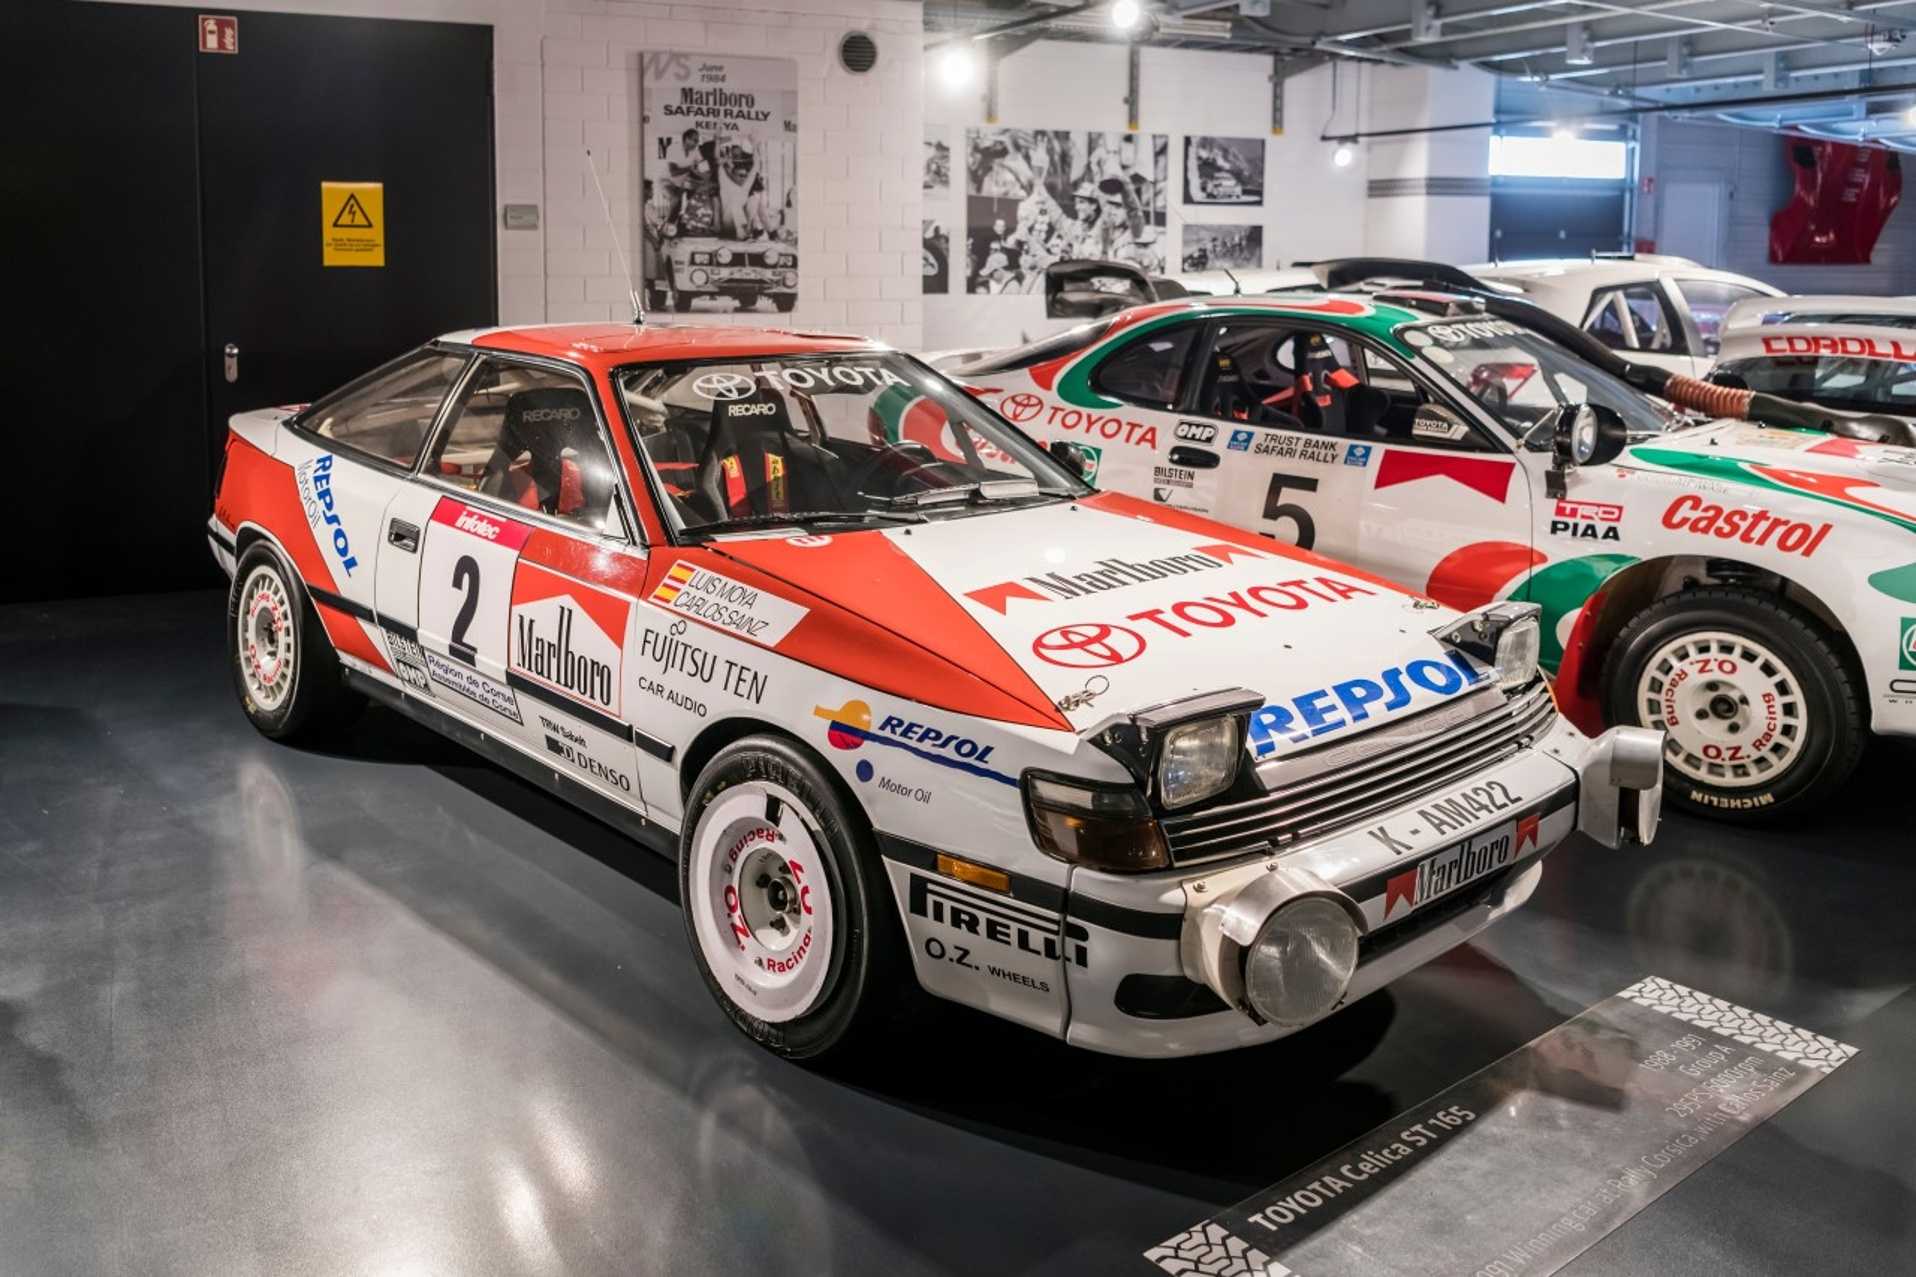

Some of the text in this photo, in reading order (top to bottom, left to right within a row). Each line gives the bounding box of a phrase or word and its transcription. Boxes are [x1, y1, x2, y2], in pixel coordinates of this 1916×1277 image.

[698, 63, 724, 73] June
[700, 74, 727, 83] 1984
[663, 104, 771, 121] SAFARI RALLY
[680, 87, 755, 108] Marlboro
[754, 366, 911, 391] TOYOTA
[522, 407, 581, 422] RECARO
[728, 403, 776, 417] RECARO
[1048, 406, 1158, 450] TOYOTA
[1177, 423, 1216, 441] OMP
[1263, 433, 1301, 447] TRUST
[1303, 438, 1338, 451] BANK
[1153, 466, 1195, 481] BILSTEIN
[1254, 443, 1297, 459] SAFARI
[1298, 450, 1339, 464] RALLY
[313, 454, 358, 578] REPSOL
[1260, 472, 1319, 551] 5
[1551, 520, 1620, 541] PIAA
[1662, 495, 1834, 558] Castrol
[688, 571, 758, 610] LUIS MOYA
[1026, 547, 1225, 601] Marlboro
[448, 554, 481, 668] 2
[673, 591, 769, 637] CARLOS SAINZ
[1127, 576, 1377, 638] TOYOTA
[516, 605, 612, 707] Marlboro
[640, 628, 768, 705] FUJITSU TEN
[482, 681, 515, 706] Corse
[638, 677, 708, 718] CAR AUDIO
[1247, 649, 1490, 759] REPSOL
[1665, 669, 1689, 726] Racing
[878, 715, 995, 764] REPSOL
[1702, 692, 1777, 761] O.Z. Racing
[577, 752, 630, 791] DENSO
[878, 776, 931, 804] Motor Oil
[1367, 826, 1414, 856] K
[1416, 780, 1523, 836] AM422
[1690, 790, 1775, 808] MICHELIN
[1414, 835, 1510, 906] Marlboro
[910, 872, 1089, 969] PIRELLI
[924, 937, 1050, 992] O.Z. WHEELS
[1638, 1050, 1676, 1072] 1988
[1670, 1034, 1707, 1053] 1991
[1679, 1044, 1736, 1077] Group A
[1248, 1105, 1476, 1231] TOYOTA Celica ST 165
[1503, 1216, 1586, 1264] Winning
[1607, 1167, 1657, 1192] Rally
[1641, 1133, 1699, 1169] Corsica
[1694, 1110, 1728, 1141] with
